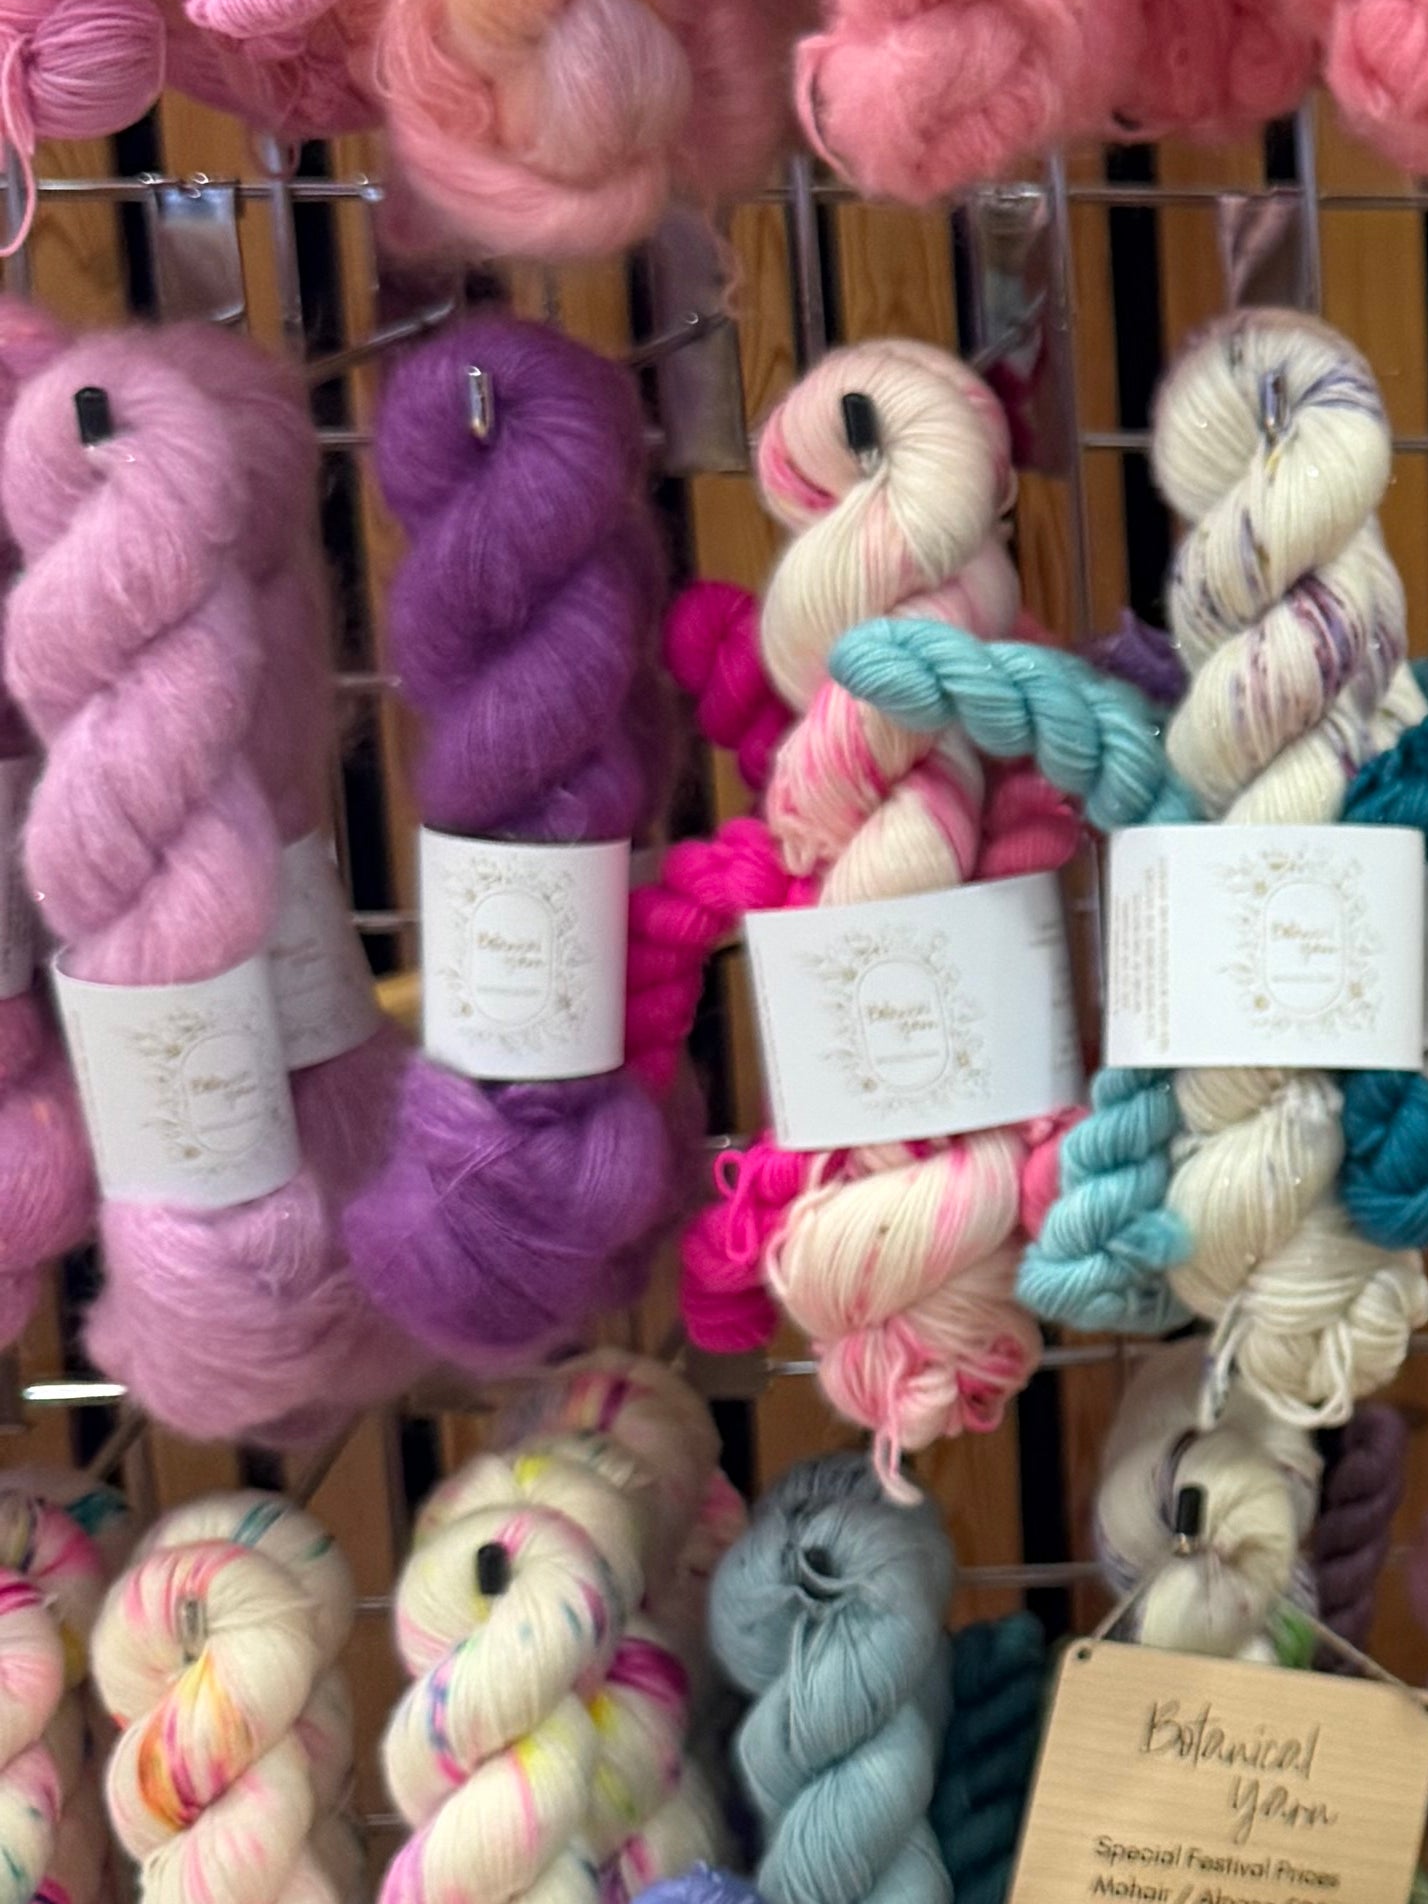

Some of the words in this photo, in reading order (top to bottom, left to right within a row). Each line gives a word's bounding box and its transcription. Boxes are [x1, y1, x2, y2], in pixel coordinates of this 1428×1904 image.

[1095, 1834, 1182, 1866] Special
[1186, 1846, 1271, 1879] Festival
[1274, 1859, 1341, 1889] Prices
[1092, 1874, 1171, 1903] Mohair
